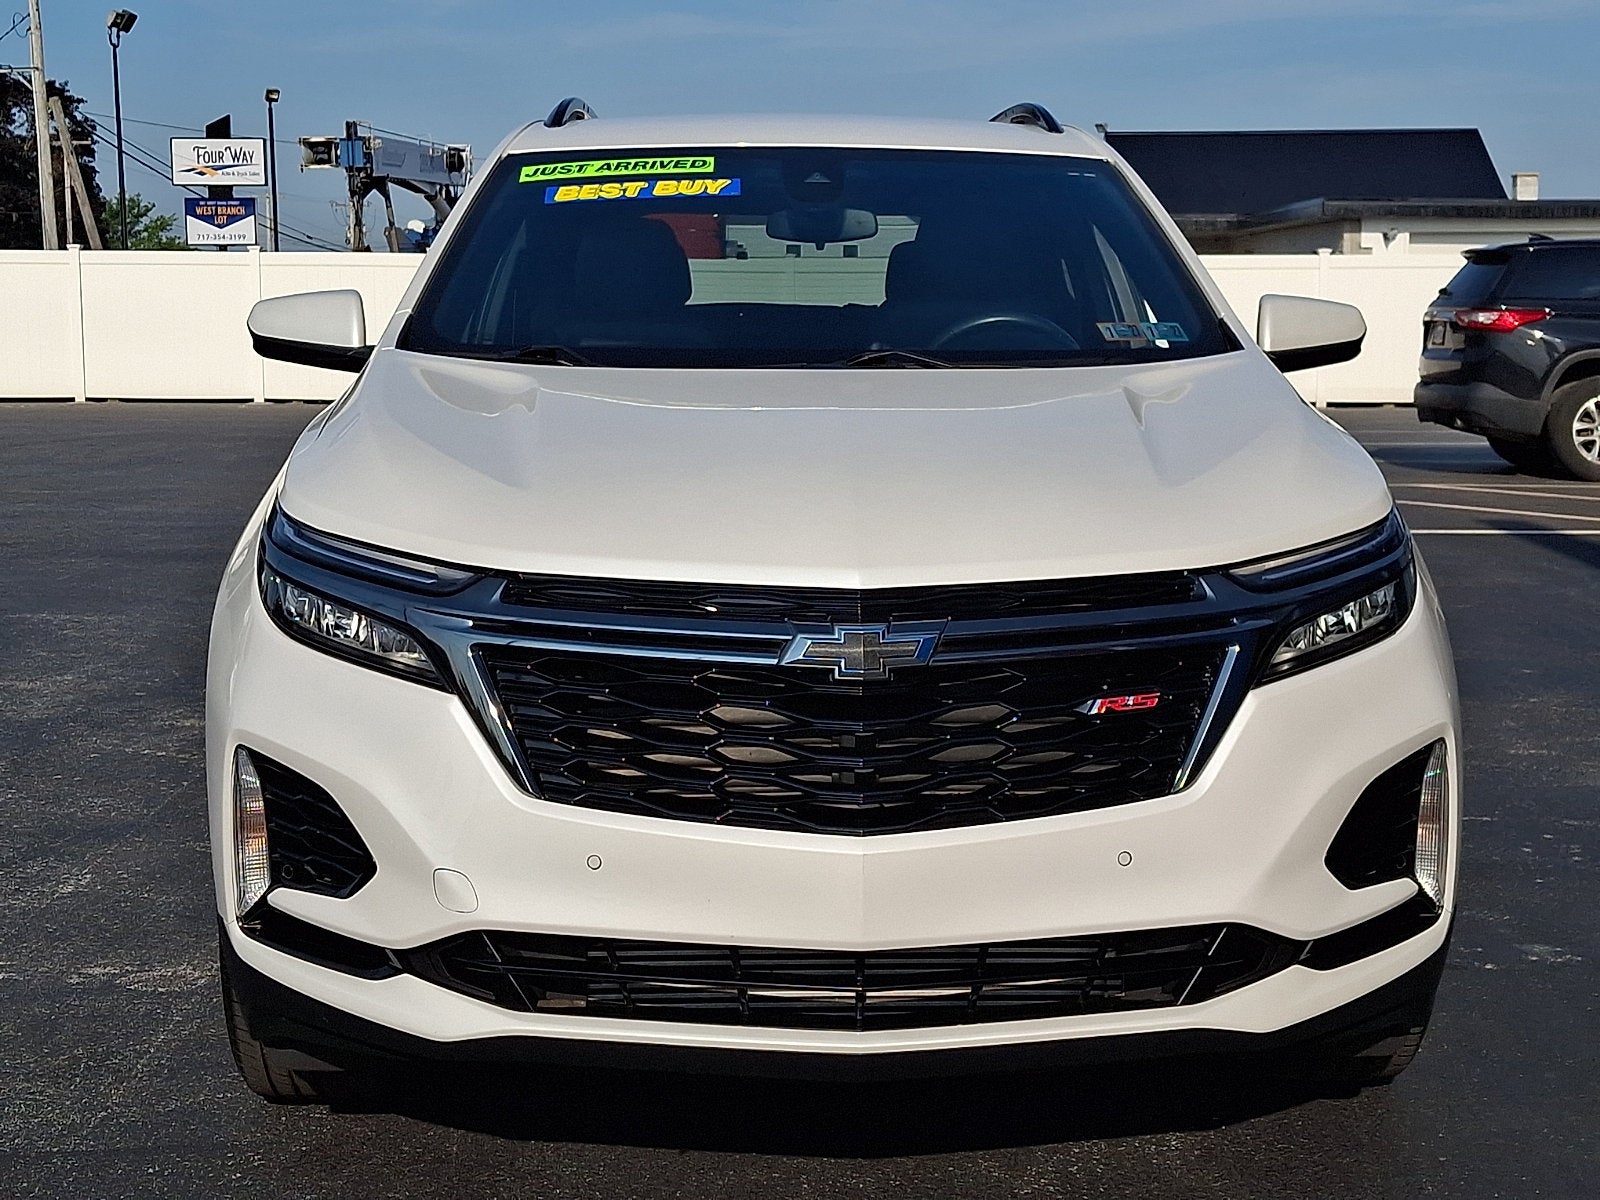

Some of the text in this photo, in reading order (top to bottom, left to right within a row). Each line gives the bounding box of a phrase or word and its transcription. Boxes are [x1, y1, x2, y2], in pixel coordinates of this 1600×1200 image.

[225, 146, 255, 164] WAY
[525, 159, 711, 177] JUST ARRIVED
[554, 178, 732, 202] BEST BUY
[195, 206, 245, 215] WEST BRANCH
[214, 215, 227, 225] LOT
[197, 233, 247, 241] 717-354-3199
[1098, 693, 1160, 713] RS
